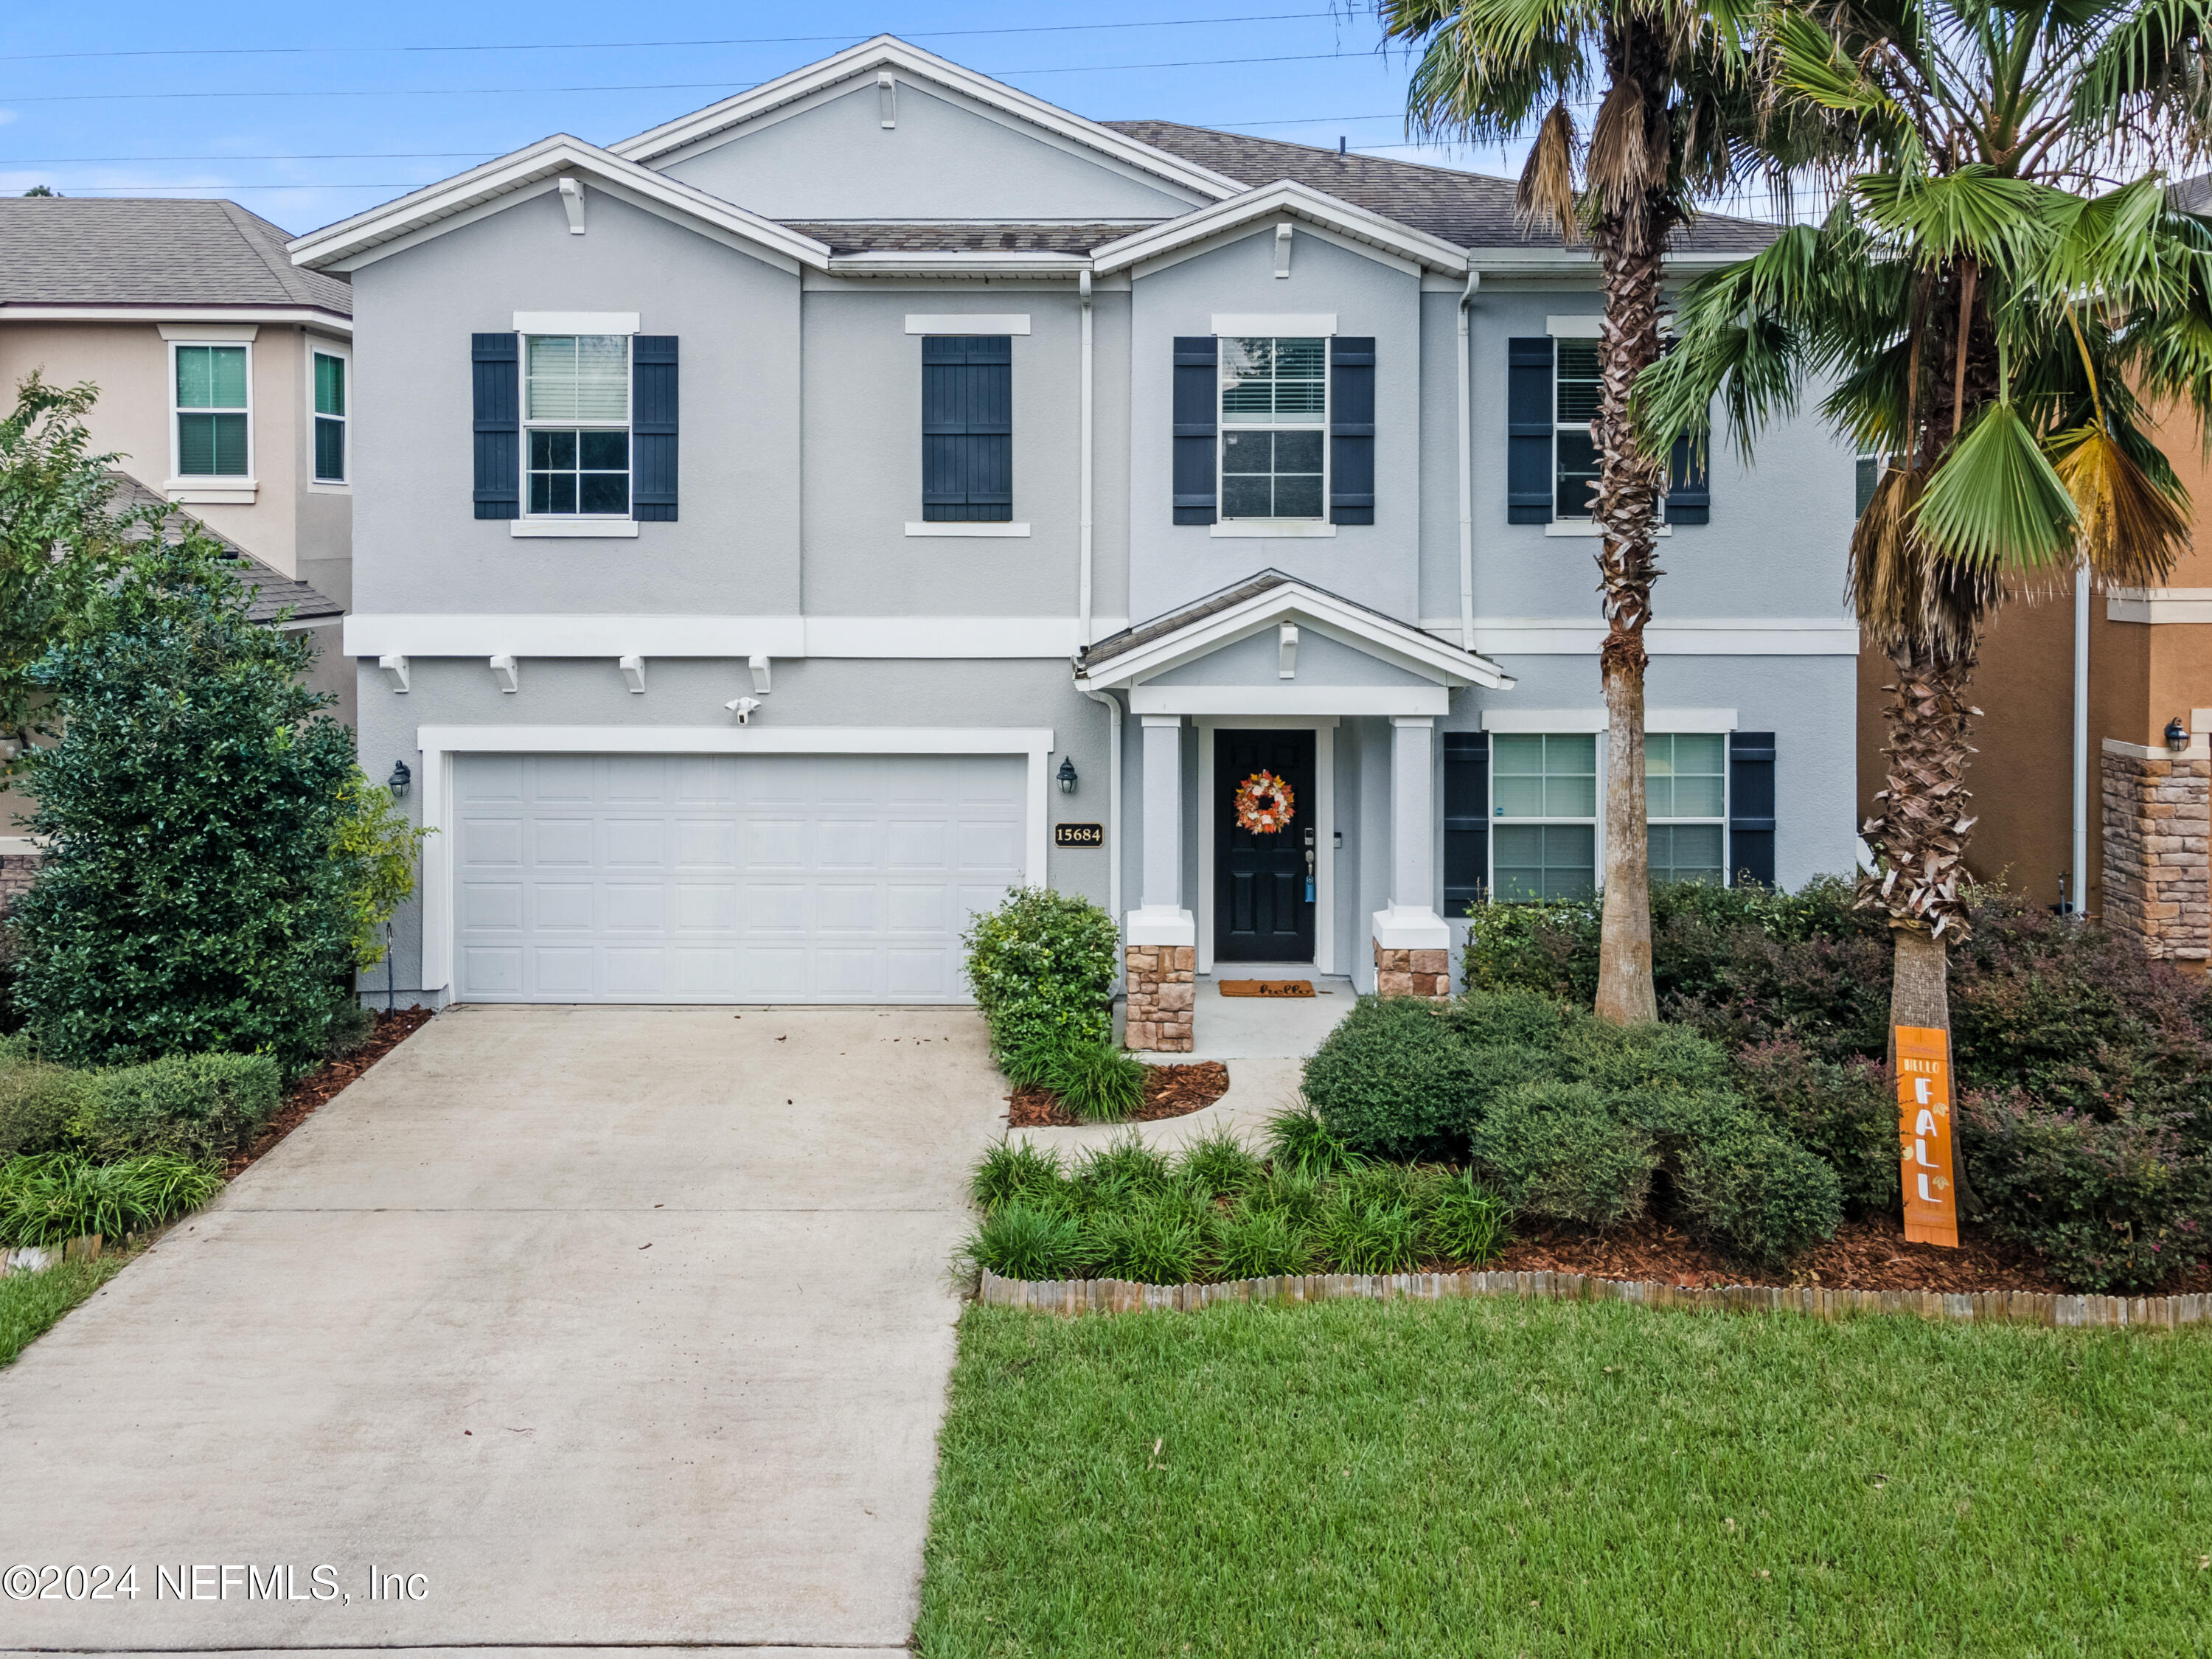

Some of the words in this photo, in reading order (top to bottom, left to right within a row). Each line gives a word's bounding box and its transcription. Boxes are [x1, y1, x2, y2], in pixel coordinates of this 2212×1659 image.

[1057, 828, 1100, 841] 15684
[1259, 984, 1311, 995] hello
[1904, 1059, 1940, 1074] HELLO
[1915, 1077, 1943, 1203] FALL
